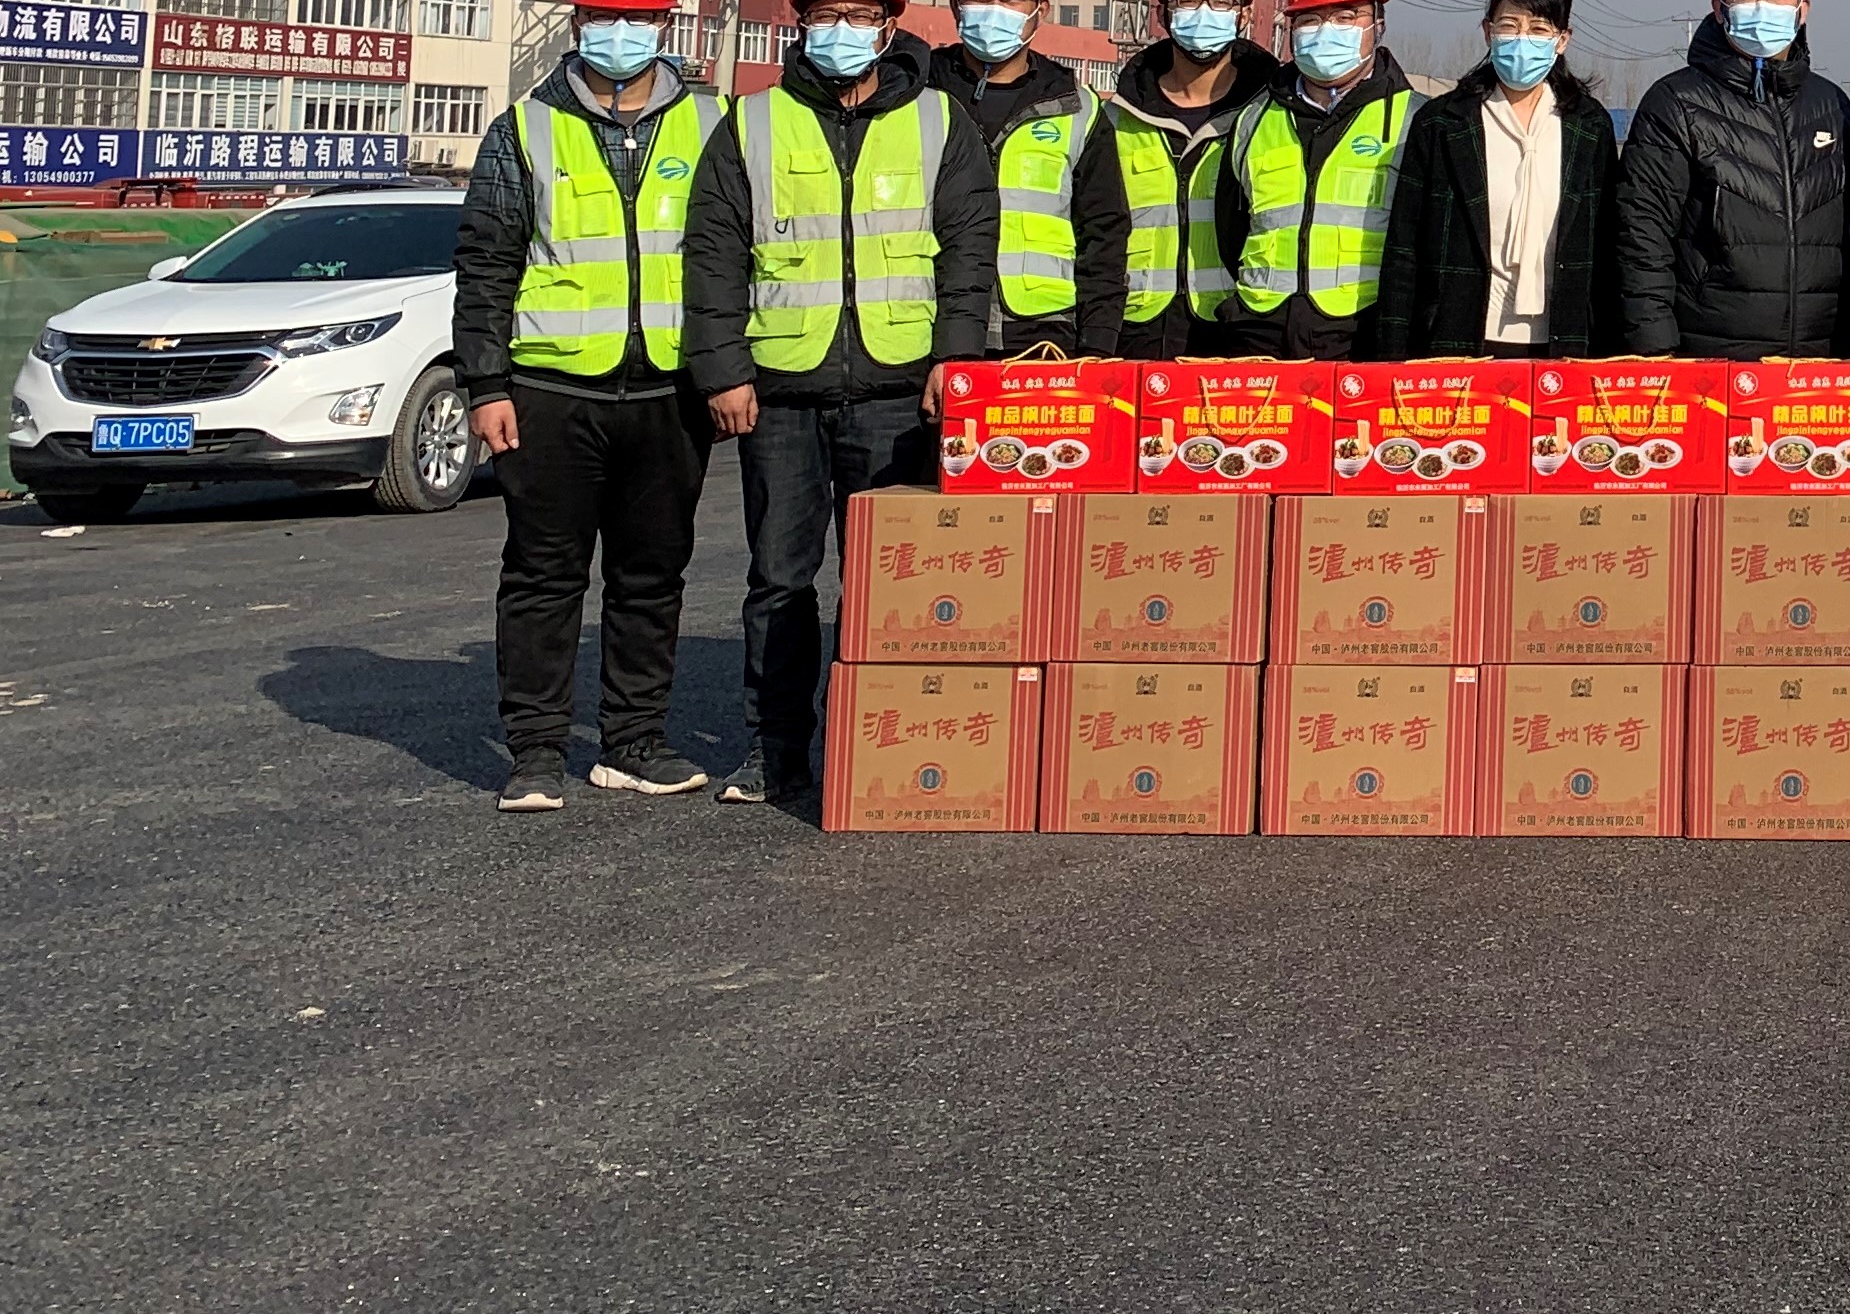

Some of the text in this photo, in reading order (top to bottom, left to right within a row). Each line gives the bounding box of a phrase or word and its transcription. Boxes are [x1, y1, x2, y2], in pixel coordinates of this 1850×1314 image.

[163, 19, 395, 60] 山东格联运输有限公司
[155, 134, 398, 168] 临沂路程运输有限公司
[985, 406, 1094, 424] 精品枫叶挂面
[1183, 405, 1293, 424] 精品枫叶挂面
[1379, 406, 1490, 425] 精品枫叶挂面
[1577, 404, 1687, 423] 精品枫叶挂面
